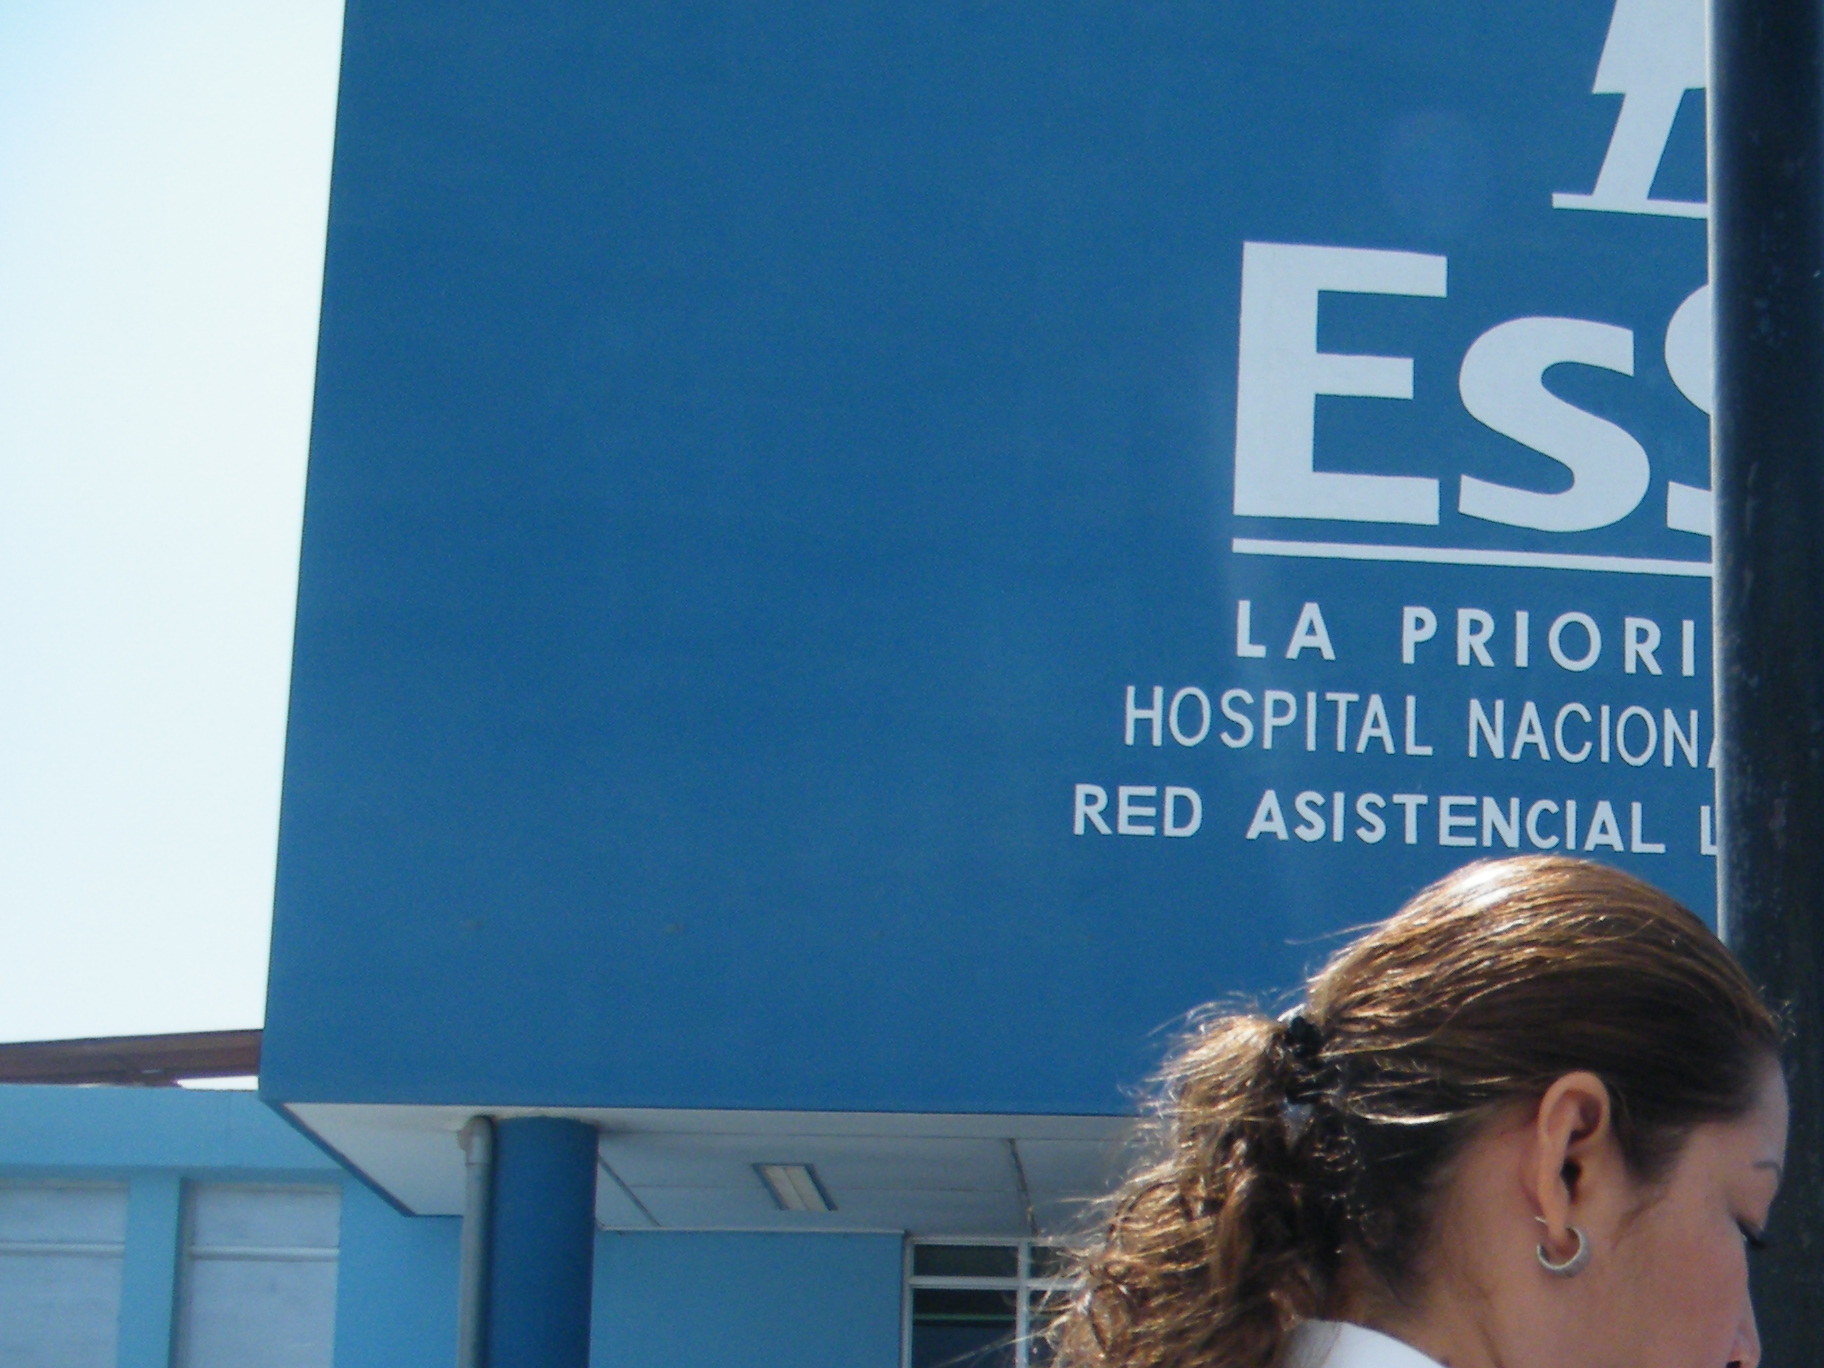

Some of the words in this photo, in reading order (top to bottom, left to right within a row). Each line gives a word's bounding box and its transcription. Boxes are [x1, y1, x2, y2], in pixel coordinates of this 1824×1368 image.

[1236, 600, 1336, 660] LA
[1124, 685, 1433, 756] HOSPITAL
[1468, 698, 1719, 769] NACION
[1073, 783, 1202, 837] RED
[1245, 789, 1666, 854] ASISTENCIAL
